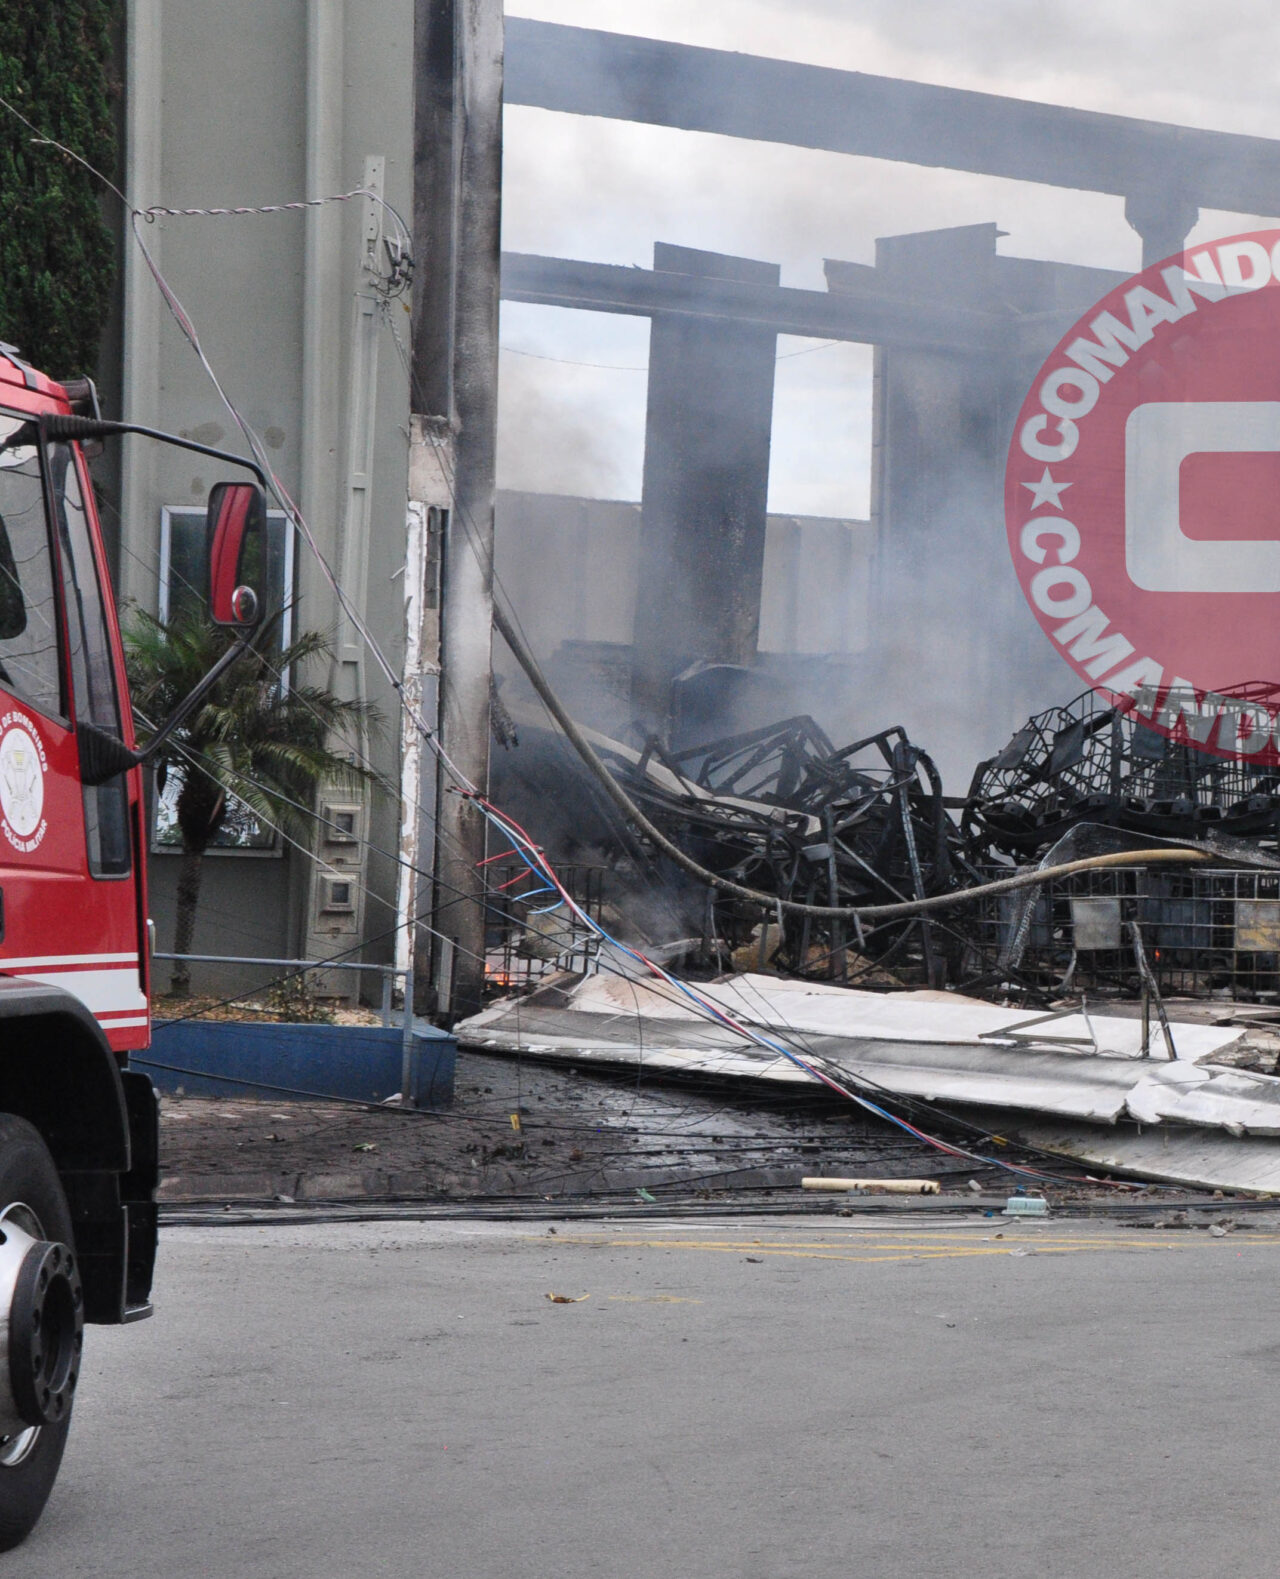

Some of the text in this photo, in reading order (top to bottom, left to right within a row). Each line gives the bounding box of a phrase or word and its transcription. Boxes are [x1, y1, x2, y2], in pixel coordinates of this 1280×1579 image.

[2, 711, 48, 772] DE BOMBEIROS
[25, 819, 48, 853] MILITAR
